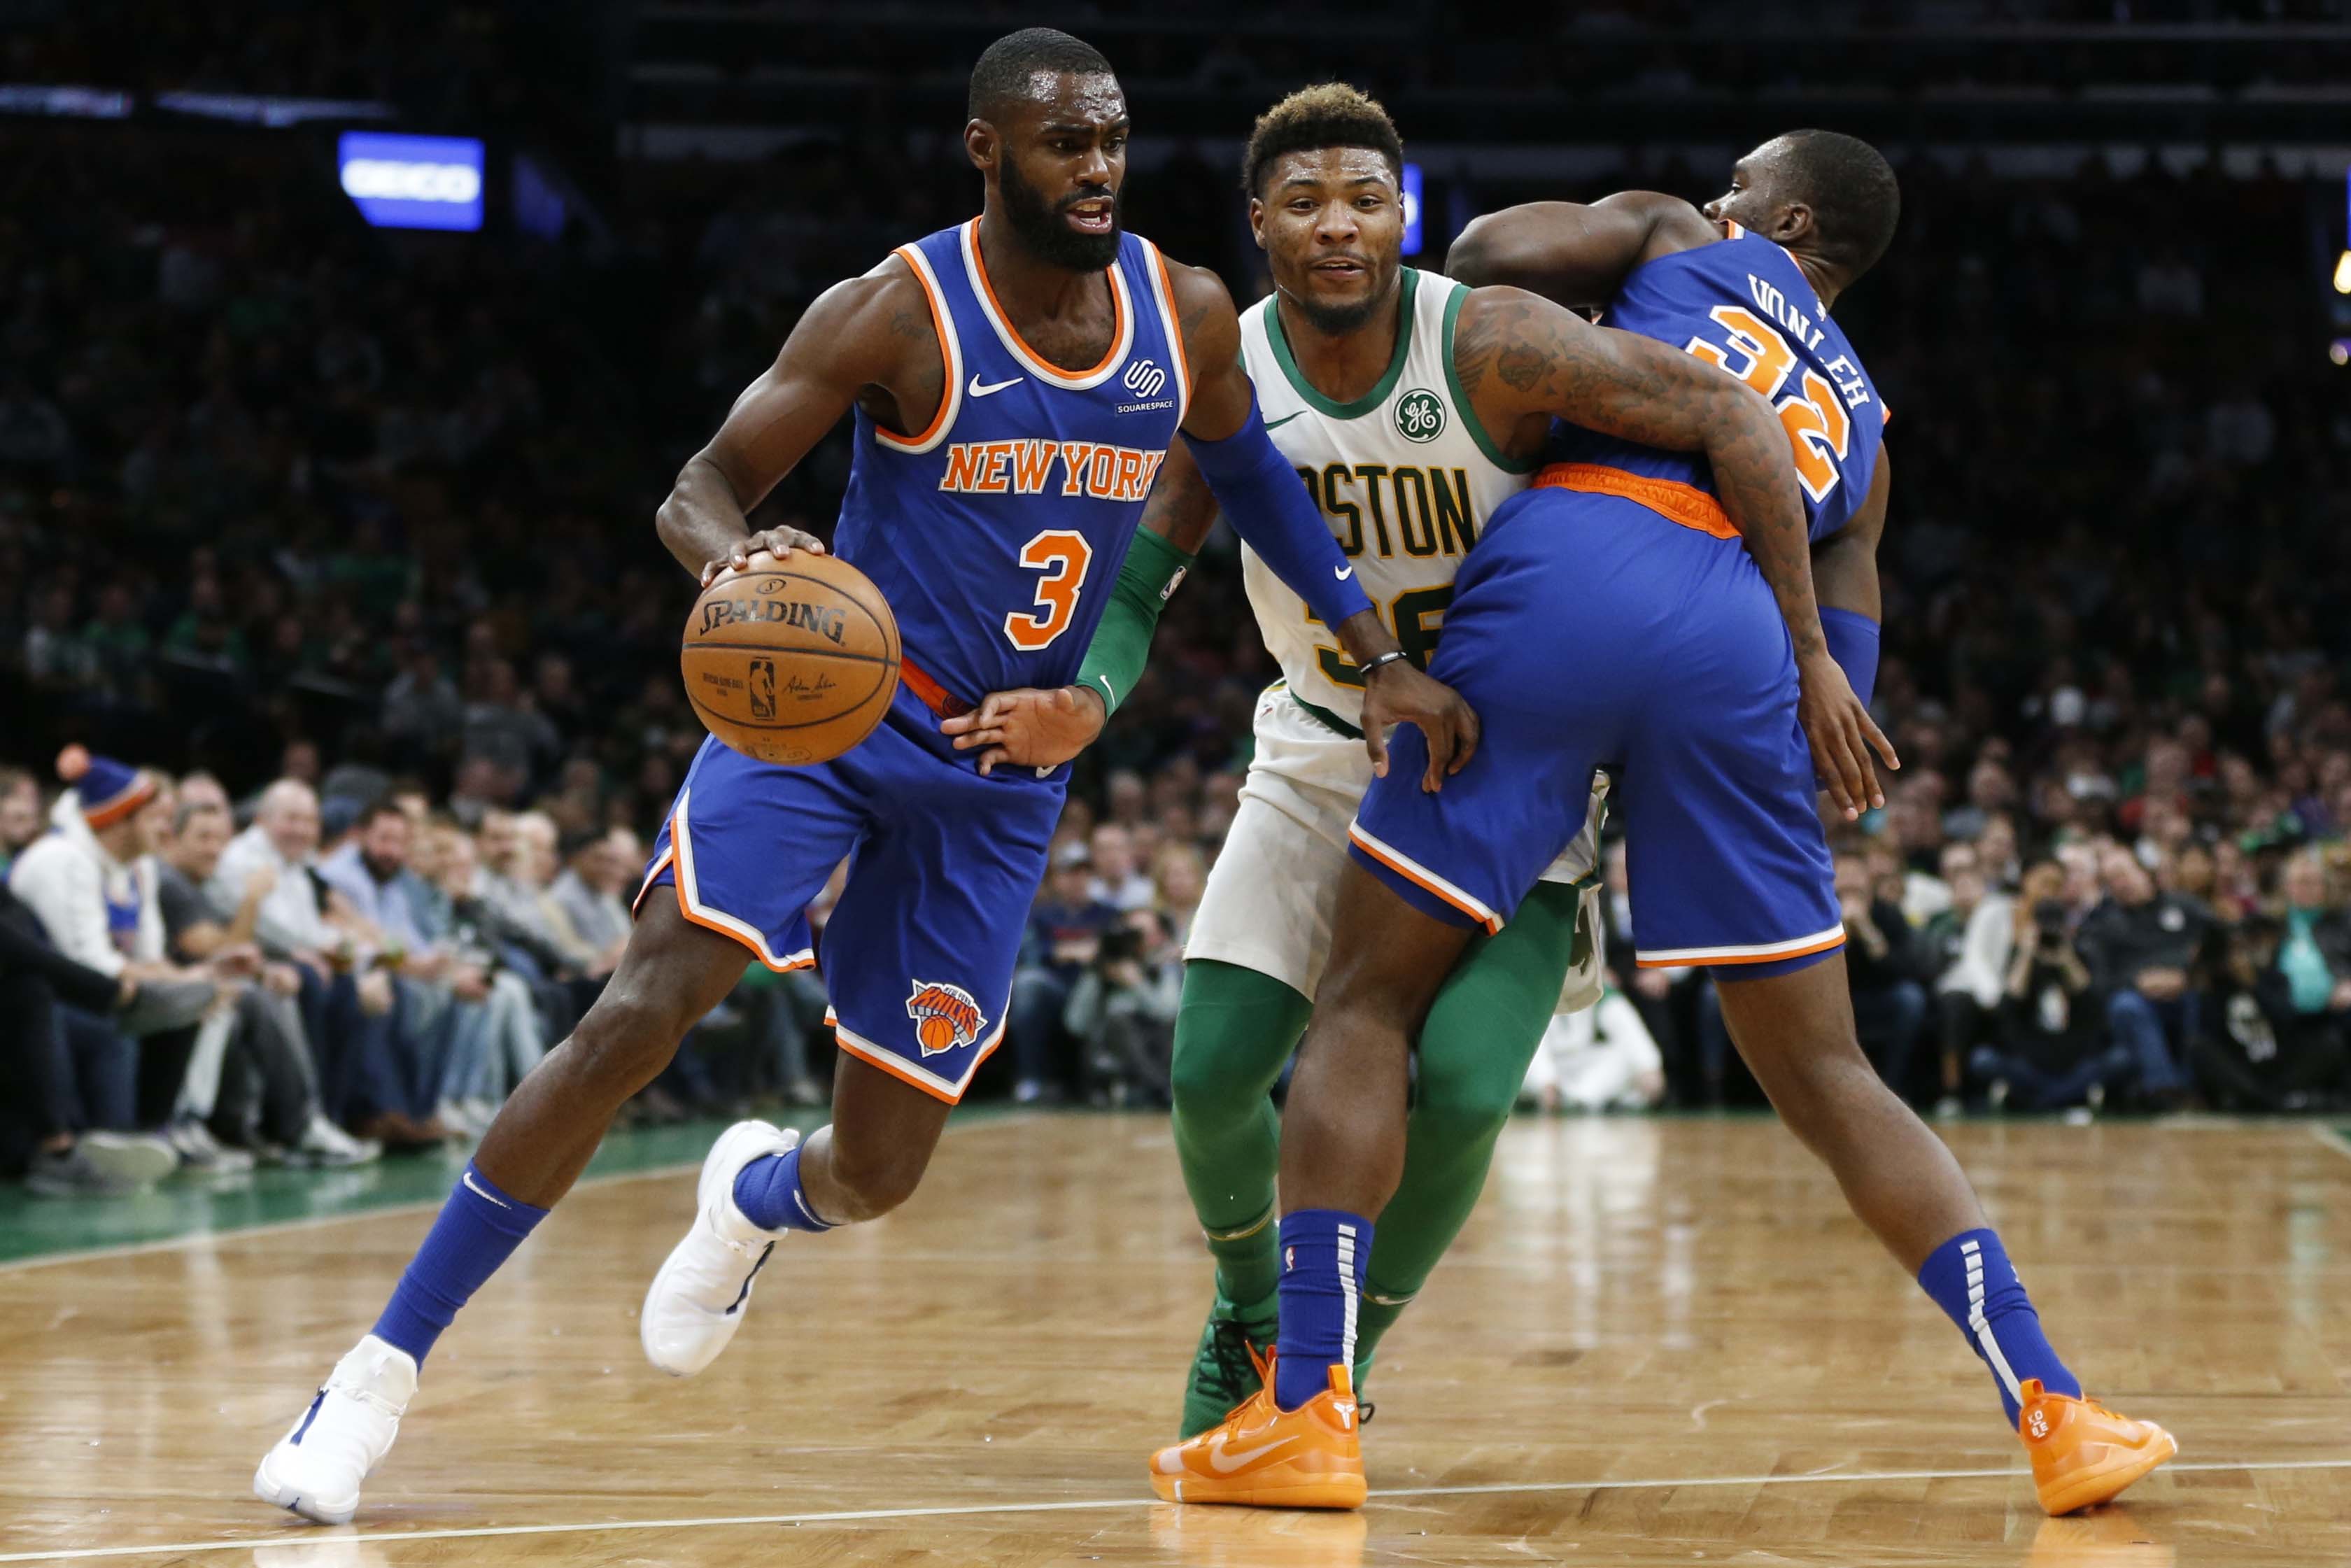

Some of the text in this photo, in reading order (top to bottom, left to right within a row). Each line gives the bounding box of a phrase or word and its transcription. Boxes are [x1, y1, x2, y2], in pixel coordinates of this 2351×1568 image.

[1746, 273, 1870, 410] VONLEH
[1117, 400, 1174, 414] SQUARESPACE
[1686, 304, 1851, 504] 32
[938, 438, 1167, 502] NEW YORK
[700, 599, 846, 645] SPALDING
[1003, 529, 1093, 651] 3
[910, 987, 978, 1040] KNICKS
